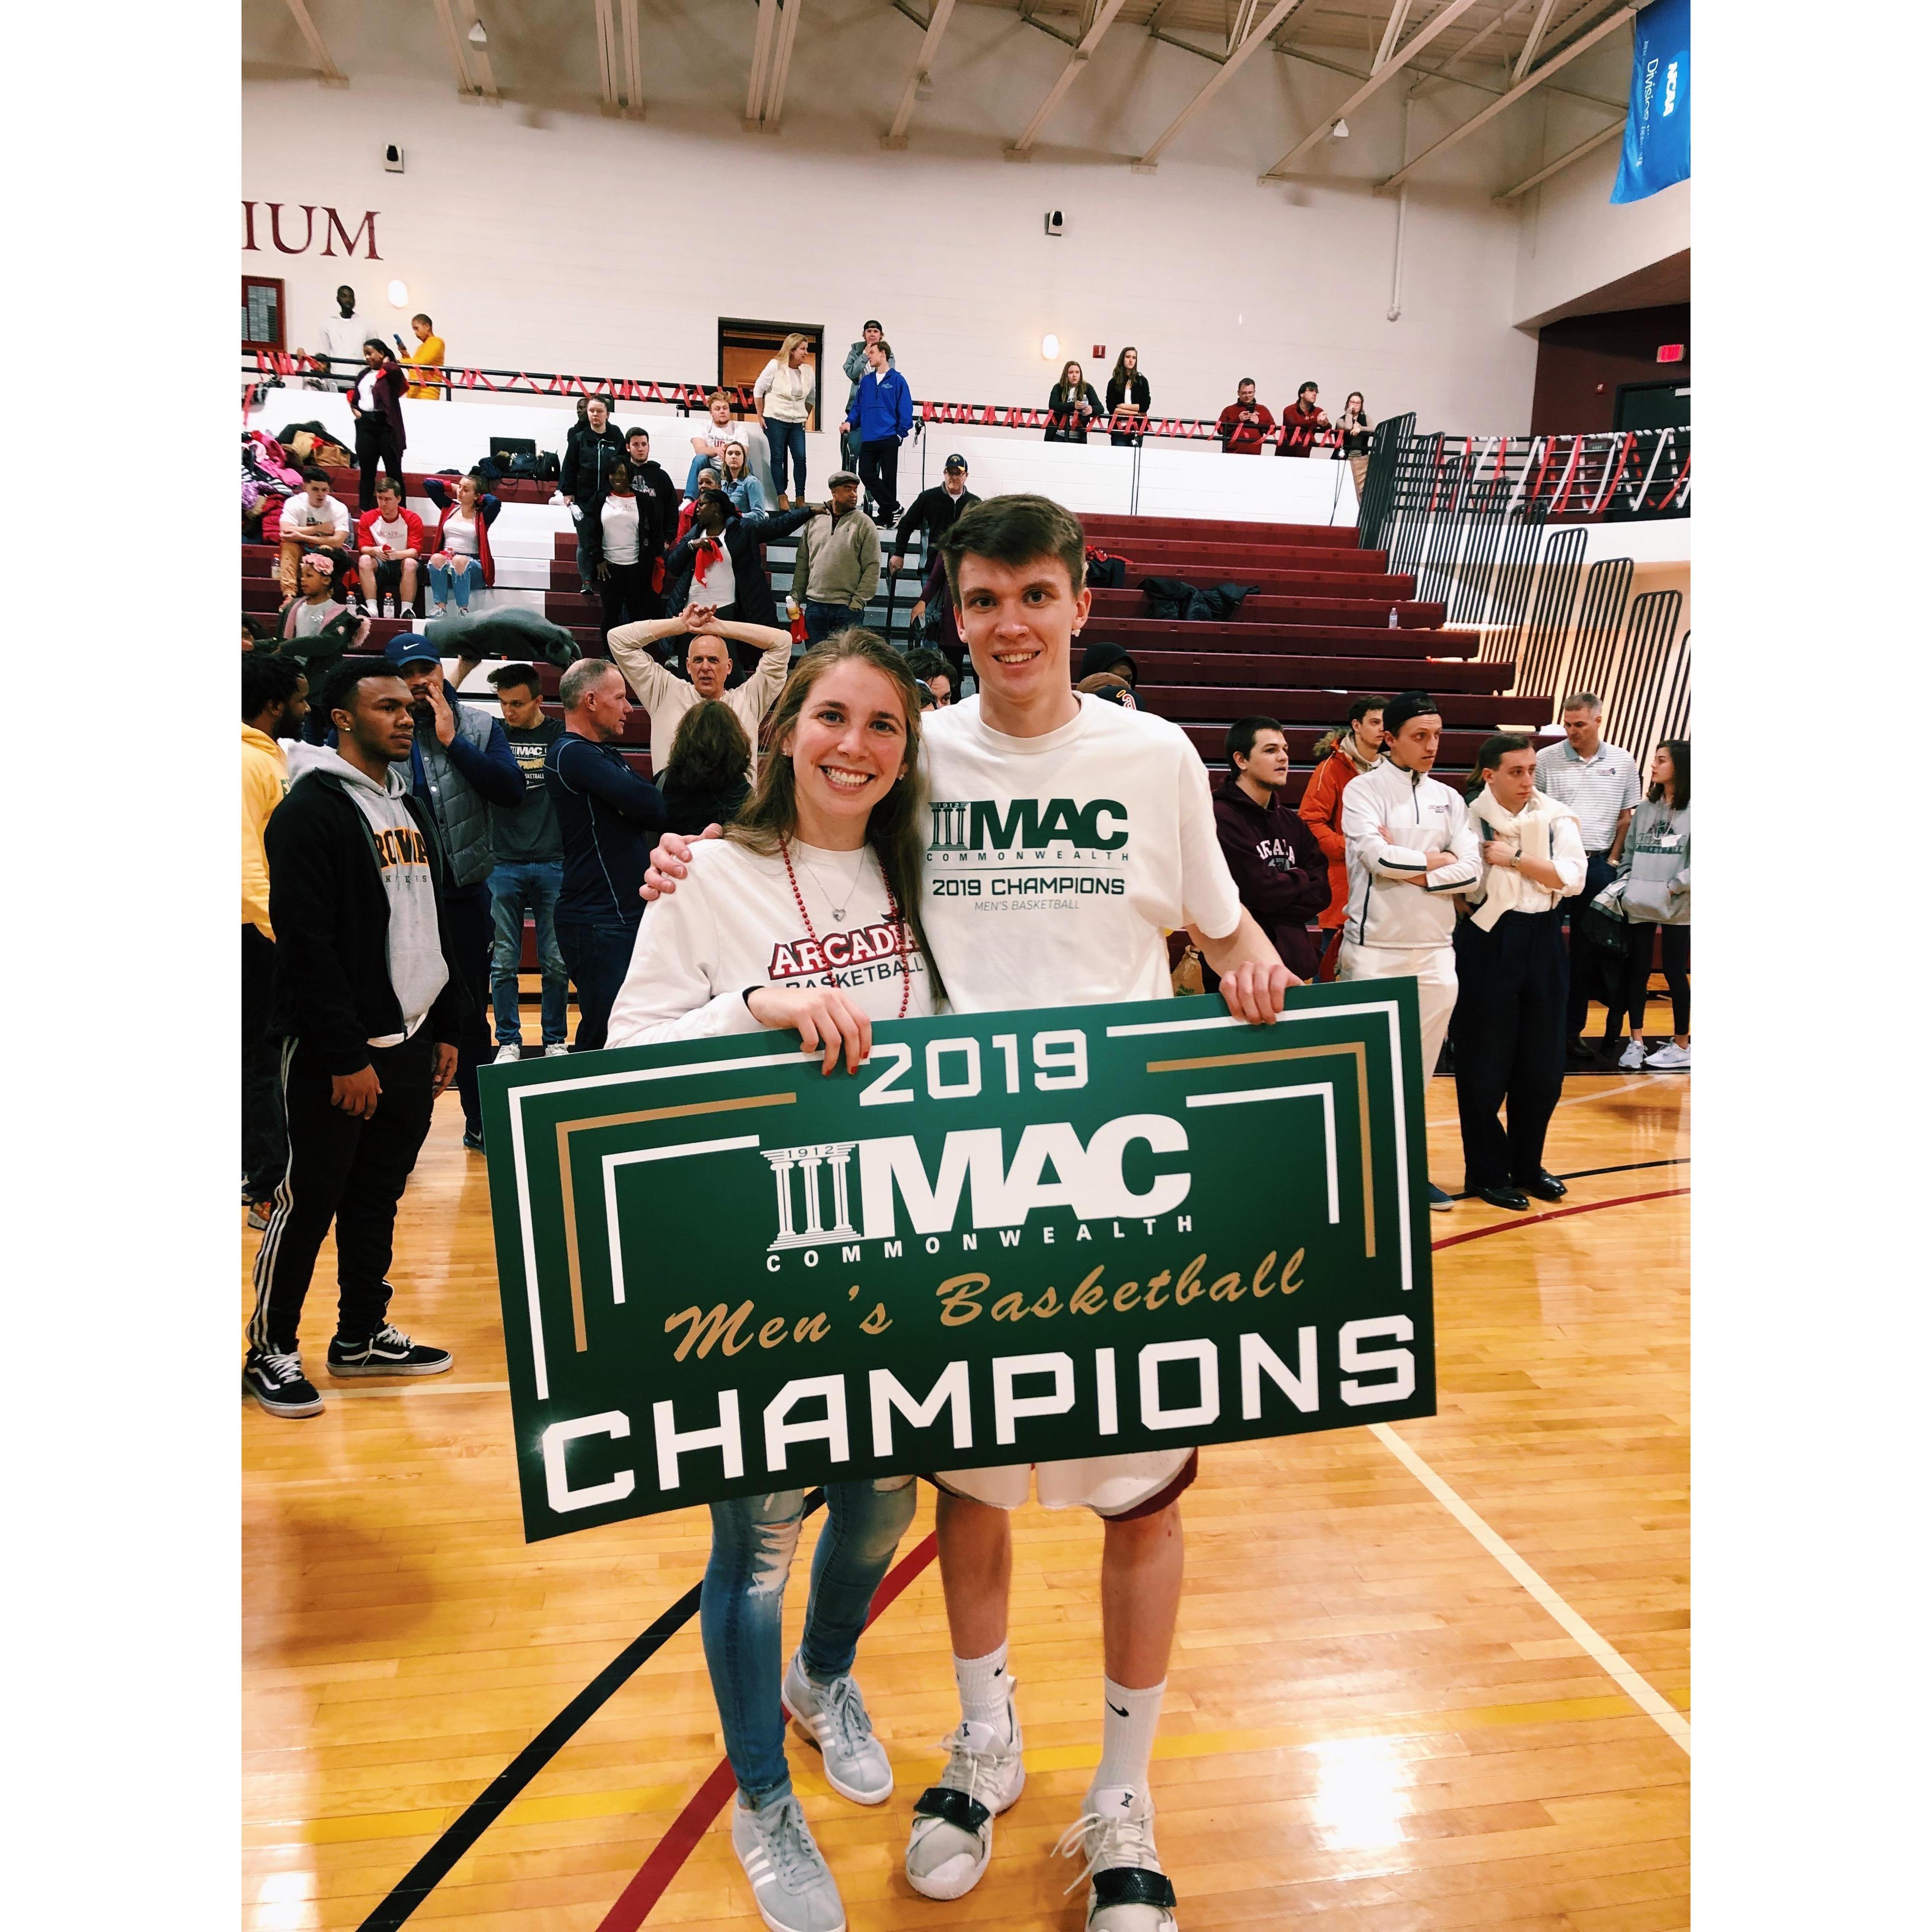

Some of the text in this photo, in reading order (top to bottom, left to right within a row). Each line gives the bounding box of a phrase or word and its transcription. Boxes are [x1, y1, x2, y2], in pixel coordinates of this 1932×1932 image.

[1663, 61, 1678, 117] NCAA
[242, 200, 384, 261] IUM
[517, 746, 543, 756] MAC
[970, 798, 1129, 851] MAC
[927, 850, 1129, 862] COMMONWEALTH
[932, 877, 1125, 896] 2019 CHAMPIONS
[975, 899, 1080, 911] MEN'S BASKETBALL
[859, 1029, 1088, 1106] 2019
[787, 1146, 834, 1159] 1912
[859, 1113, 1192, 1240] MAC
[766, 1216, 1192, 1272] COMMONWEALTH
[664, 1247, 1306, 1362] Men's Basketball
[541, 1313, 1416, 1514] CHAMPIONS
